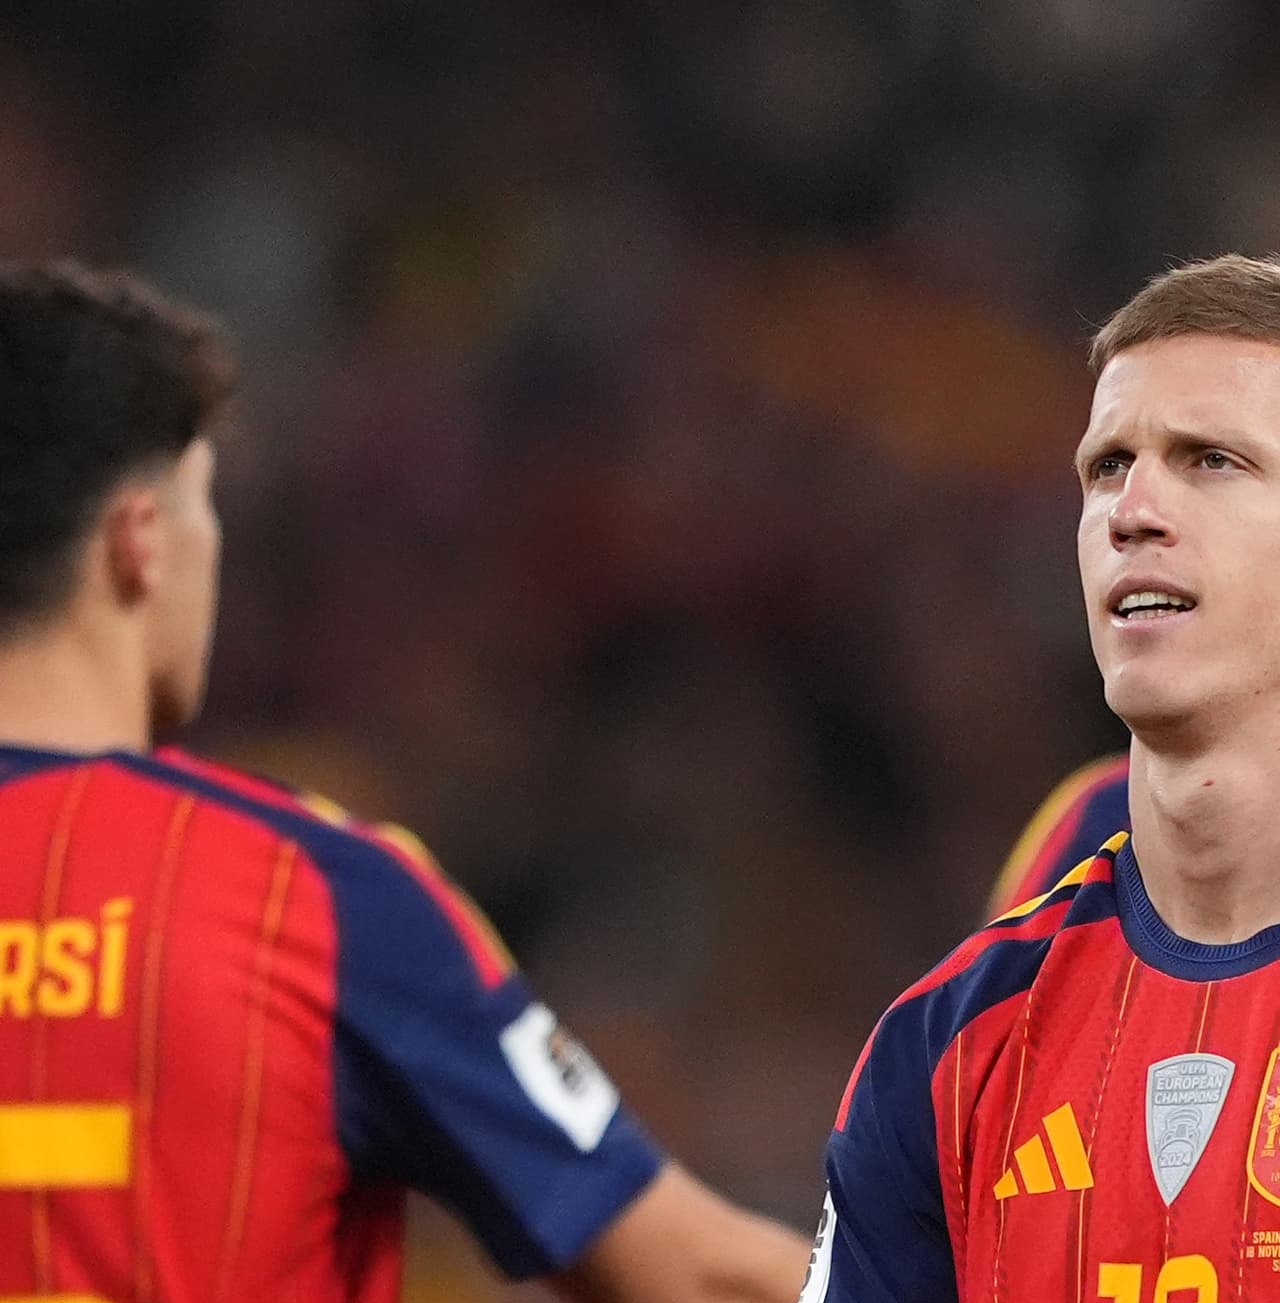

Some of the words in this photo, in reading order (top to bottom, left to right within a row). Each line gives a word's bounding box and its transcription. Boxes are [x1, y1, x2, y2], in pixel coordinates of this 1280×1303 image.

[1156, 1073, 1225, 1090] EUROPEAN
[1154, 1090, 1220, 1105] CHAMPIONS
[1158, 1150, 1192, 1168] 2024
